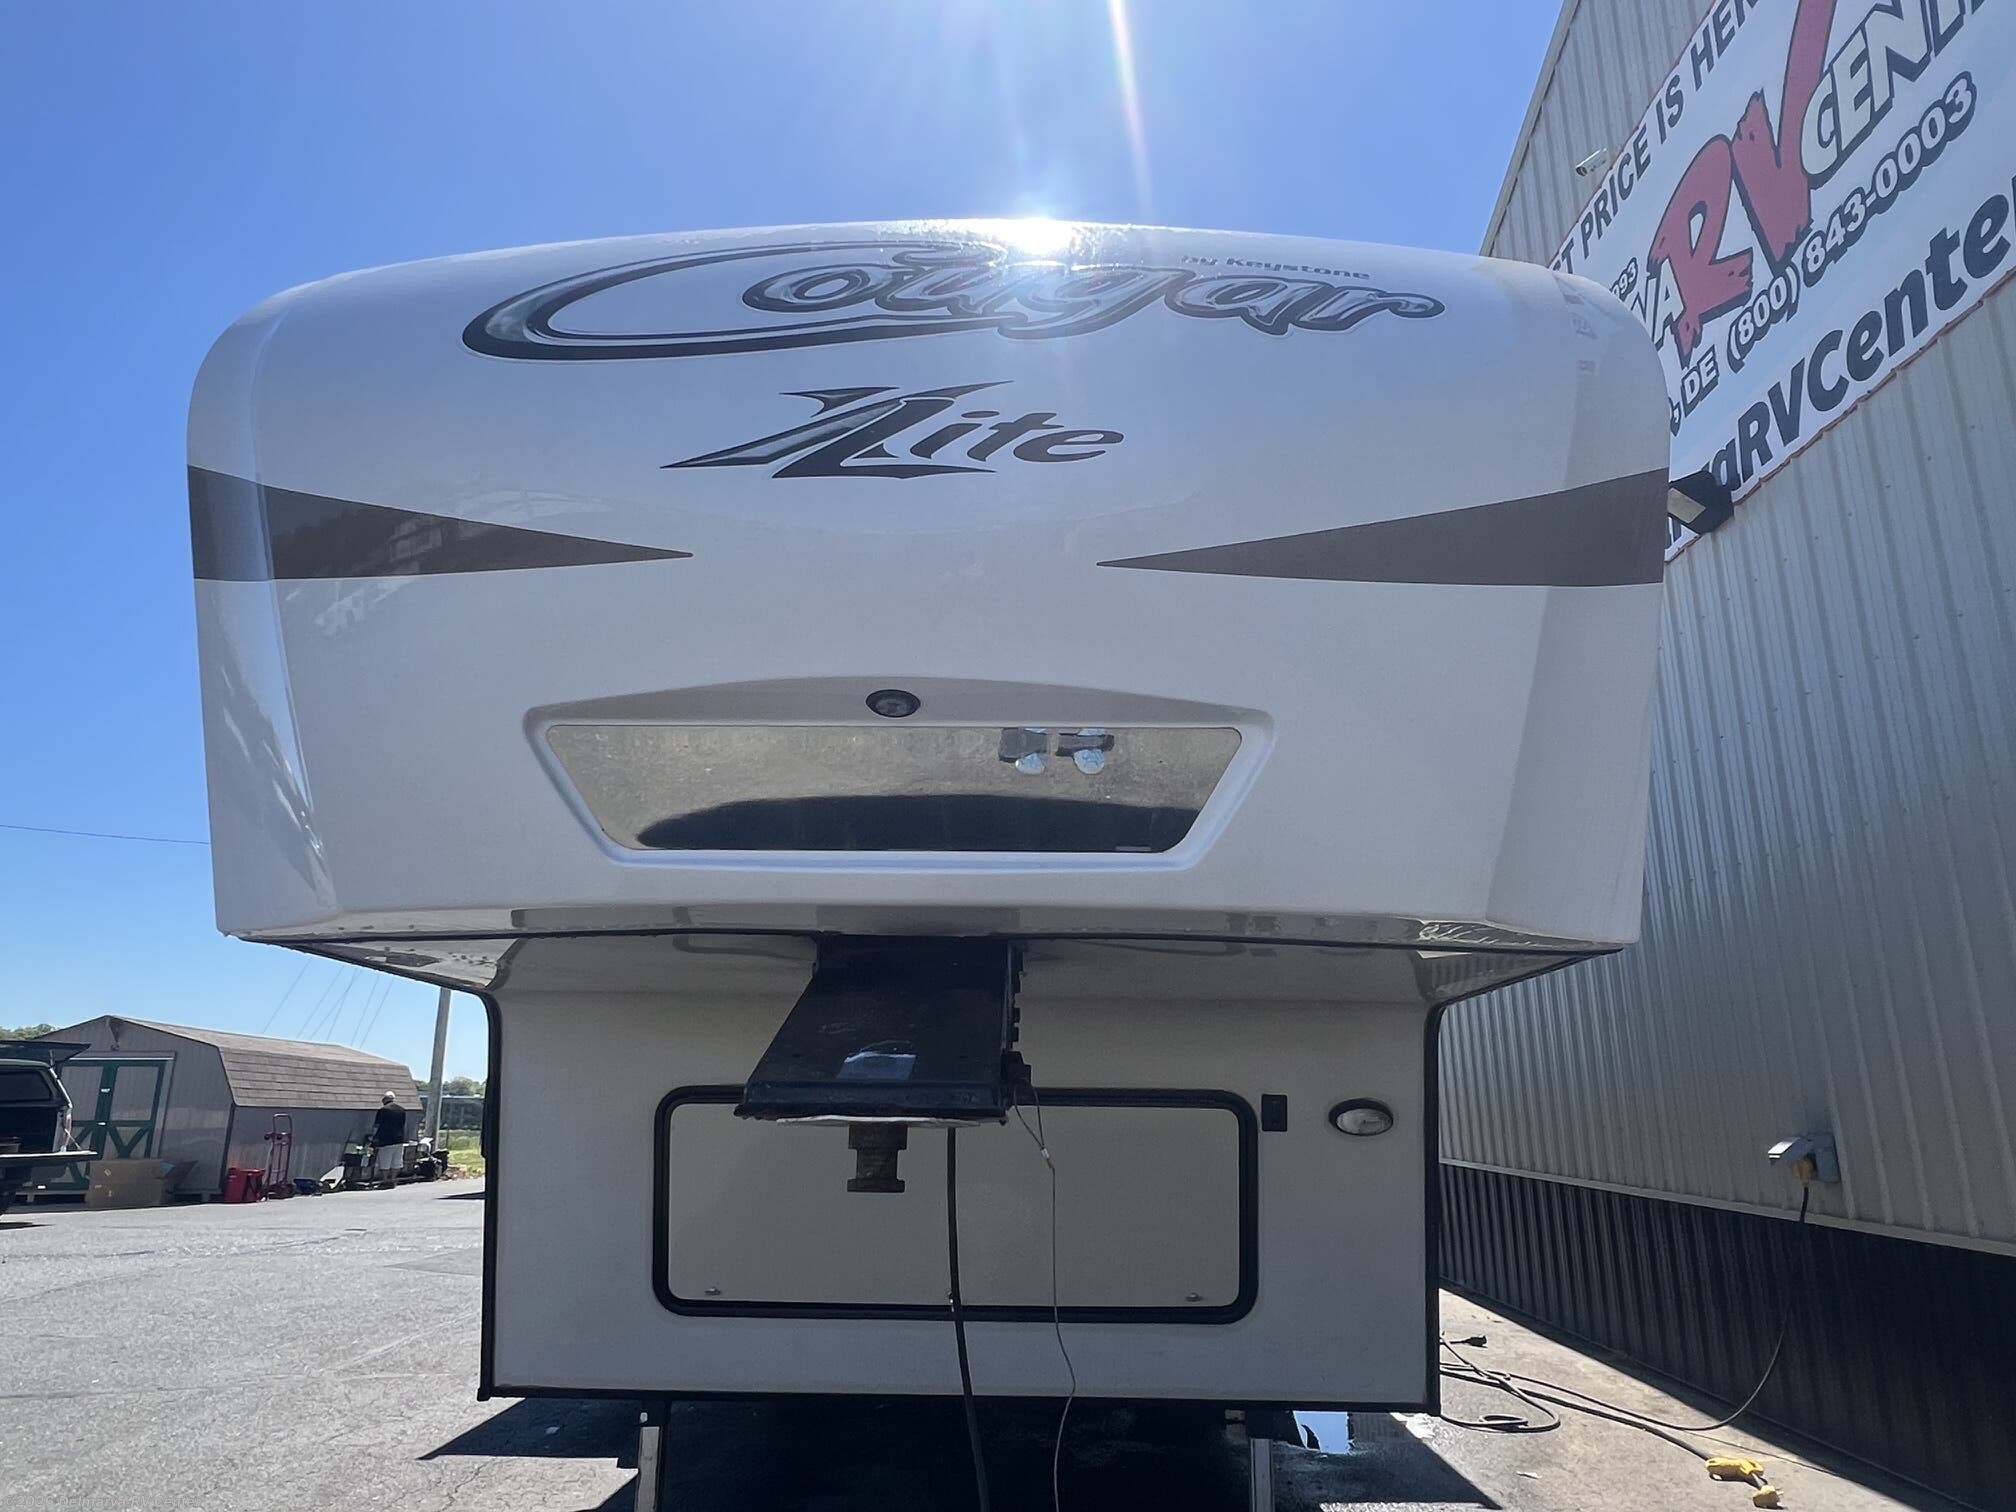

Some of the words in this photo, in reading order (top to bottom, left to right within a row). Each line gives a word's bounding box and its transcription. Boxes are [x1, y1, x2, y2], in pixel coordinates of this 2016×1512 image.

[1581, 123, 1651, 260] PRICE
[1656, 74, 1685, 145] IS
[1647, 0, 1837, 371] RV
[1680, 344, 1720, 418] DE
[1727, 256, 1800, 374] (800)
[1801, 70, 1978, 288] 843-0003
[462, 239, 1446, 361] Cougar
[1226, 256, 1371, 281] Keystone
